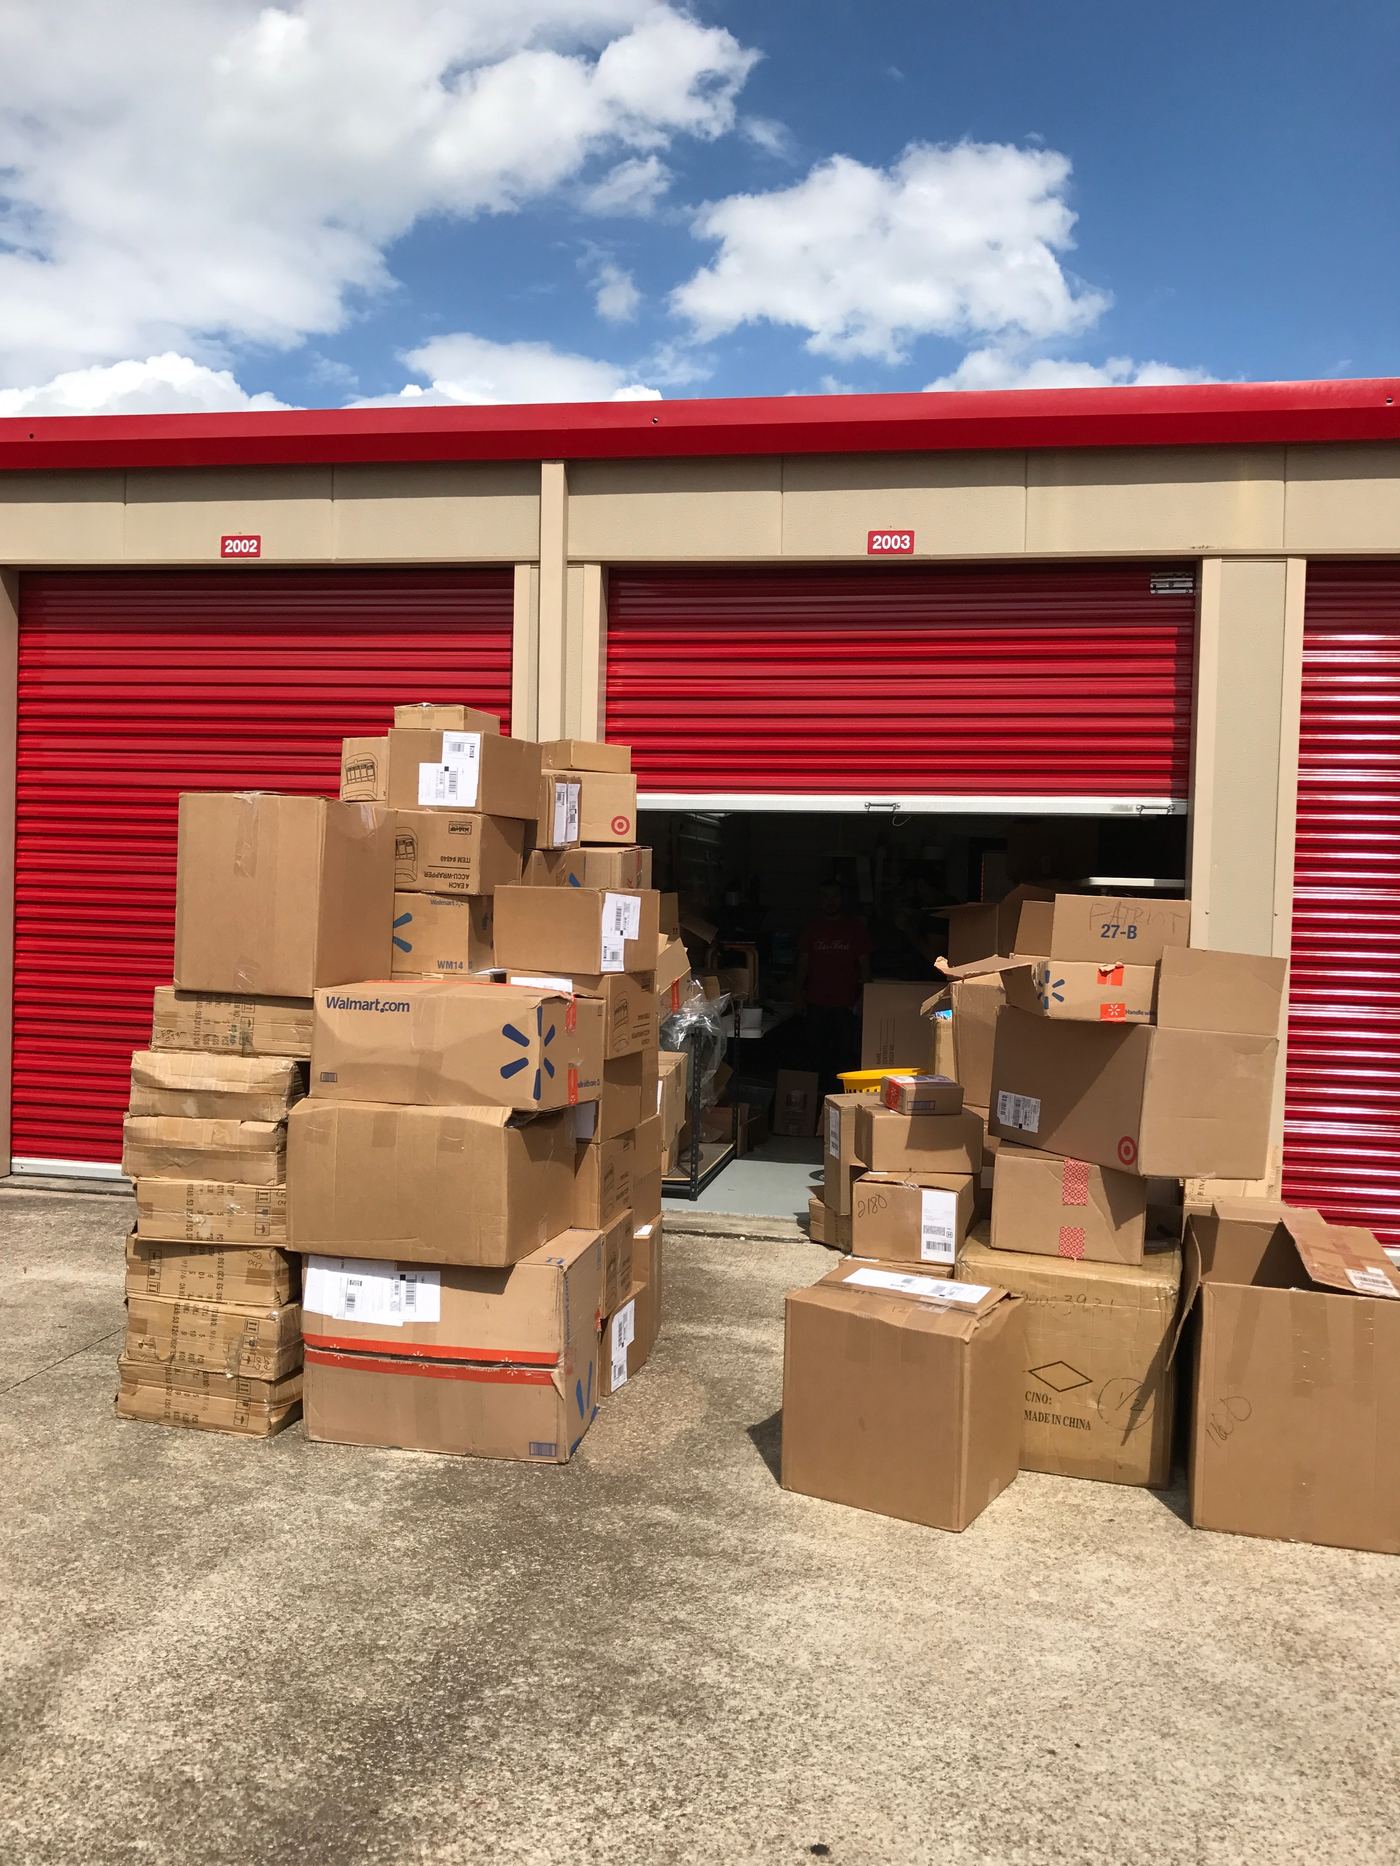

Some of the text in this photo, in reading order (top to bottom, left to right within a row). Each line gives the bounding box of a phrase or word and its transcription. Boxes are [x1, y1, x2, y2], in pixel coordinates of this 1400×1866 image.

[225, 539, 258, 553] 2002
[872, 535, 911, 550] 2003
[424, 870, 470, 880] ACCU-WRAPPER
[448, 881, 465, 889] EACH
[1100, 923, 1138, 940] 27-B
[437, 960, 464, 970] WM14
[326, 996, 410, 1013] Walmart.com
[857, 1193, 888, 1218] 2180
[1025, 1390, 1052, 1405] C/NO:
[1024, 1409, 1092, 1431] MADE IN CHINA
